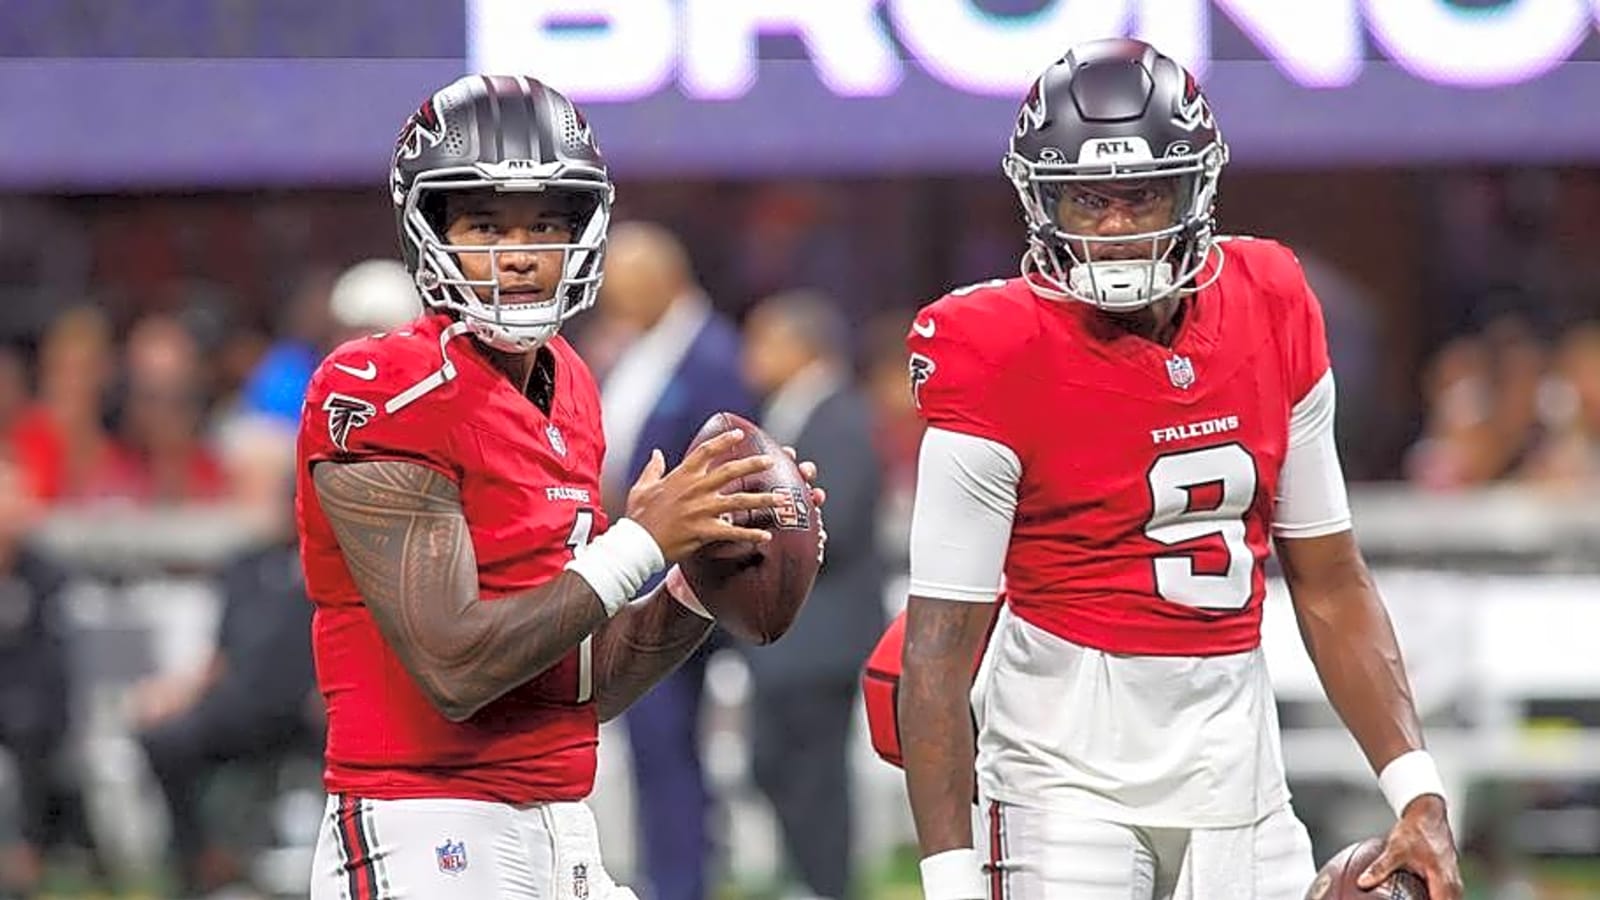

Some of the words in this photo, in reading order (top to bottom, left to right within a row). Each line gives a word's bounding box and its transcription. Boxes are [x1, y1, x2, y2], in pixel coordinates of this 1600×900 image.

[1096, 141, 1134, 158] ATL
[508, 160, 533, 169] ATL
[1150, 415, 1239, 444] FALCONS
[1144, 440, 1259, 612] 9
